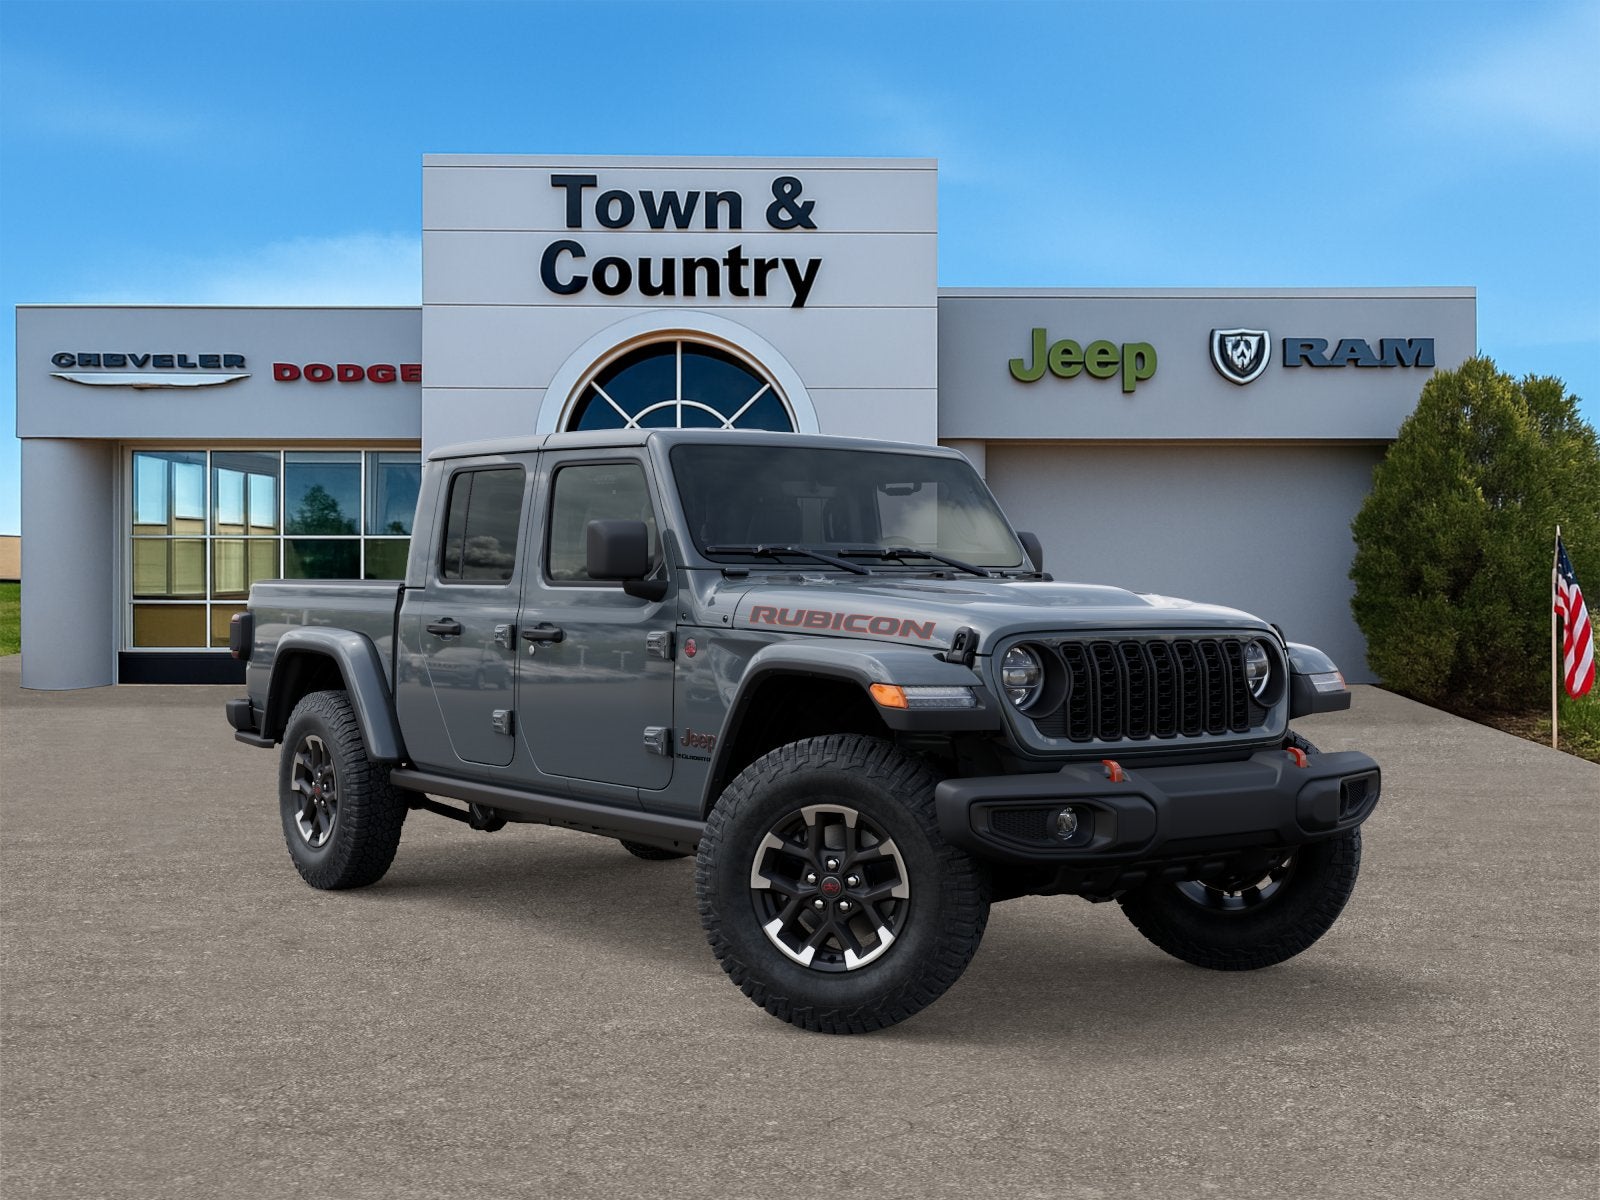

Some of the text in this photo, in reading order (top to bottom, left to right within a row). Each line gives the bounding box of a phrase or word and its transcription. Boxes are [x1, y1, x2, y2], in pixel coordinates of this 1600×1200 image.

[551, 174, 818, 229] Town &
[540, 239, 822, 308] Country
[1008, 328, 1158, 393] Jeep
[1282, 337, 1436, 368] RAM
[272, 362, 422, 383] DODGE
[749, 605, 937, 640] RUBICON
[680, 727, 717, 753] Jeep
